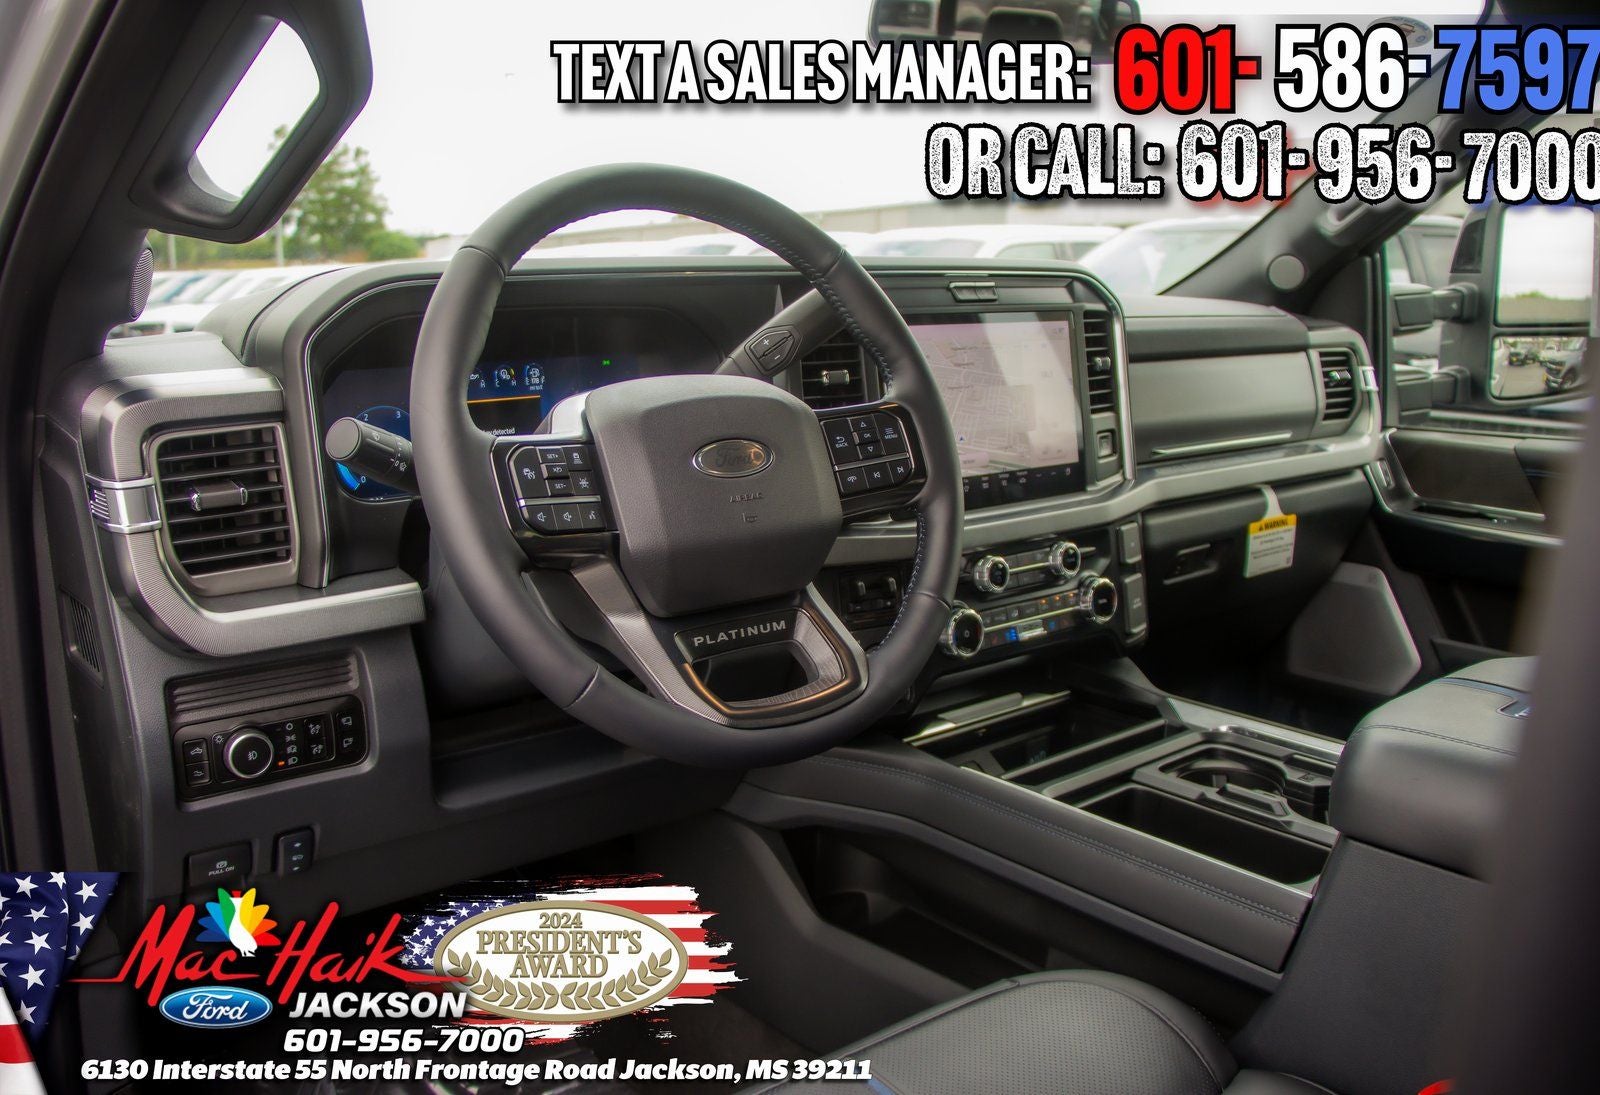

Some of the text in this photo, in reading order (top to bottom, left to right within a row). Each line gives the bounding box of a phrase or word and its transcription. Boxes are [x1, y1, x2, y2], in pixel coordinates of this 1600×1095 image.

[492, 427, 516, 436] detected
[693, 620, 787, 648] PLATINUM
[208, 869, 224, 877] PULL
